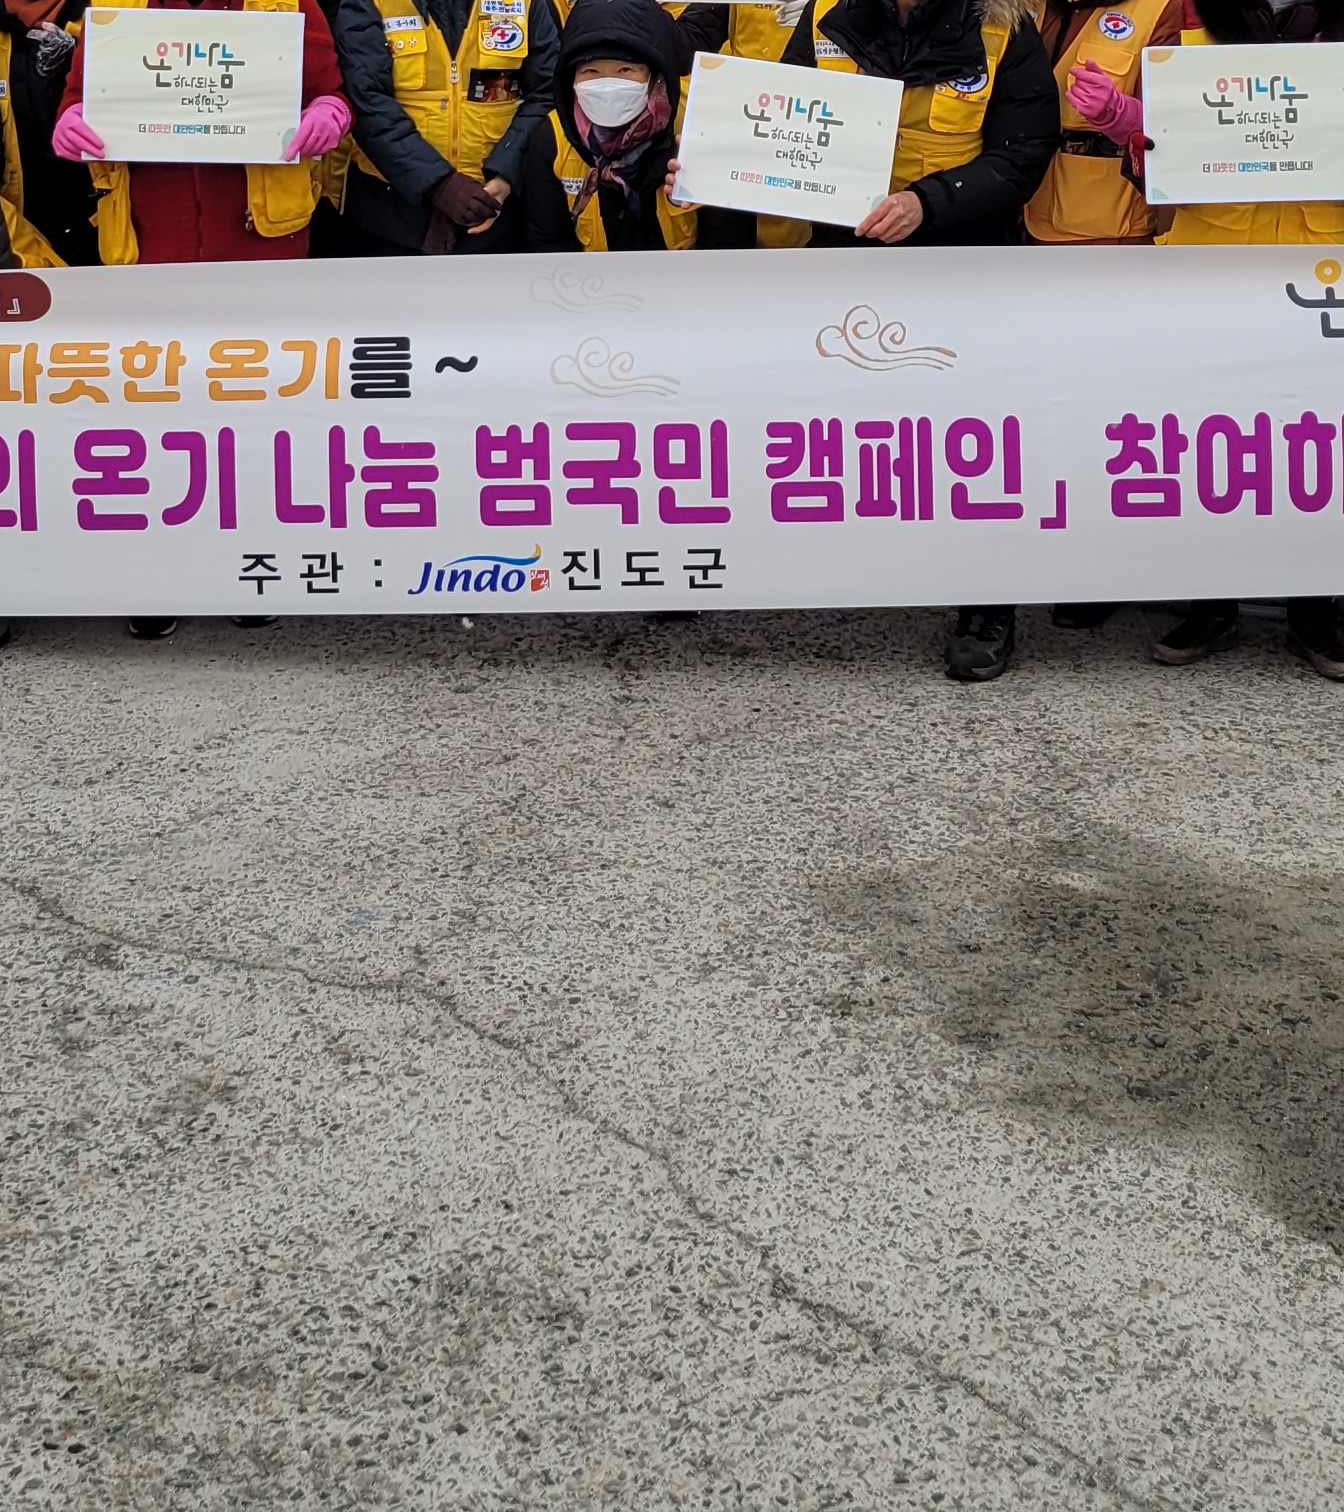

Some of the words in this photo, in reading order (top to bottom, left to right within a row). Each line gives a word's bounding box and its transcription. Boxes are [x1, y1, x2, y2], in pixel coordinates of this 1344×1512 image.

[142, 42, 246, 90] 온기나눔
[172, 74, 219, 94] 하나되는
[180, 93, 230, 113] 대한민국
[1202, 75, 1309, 126] 온기나눔
[742, 92, 845, 148] 온기나눔
[1236, 109, 1283, 130] 하나되는
[771, 126, 815, 150] 하나되는
[1244, 128, 1295, 150] 대한민국
[776, 147, 824, 171] 대한민국
[204, 334, 414, 402] 온기를
[71, 425, 238, 531] 온기
[273, 423, 441, 530] 나눔
[474, 418, 733, 528] 범국민
[764, 414, 1068, 530] 캠페인」
